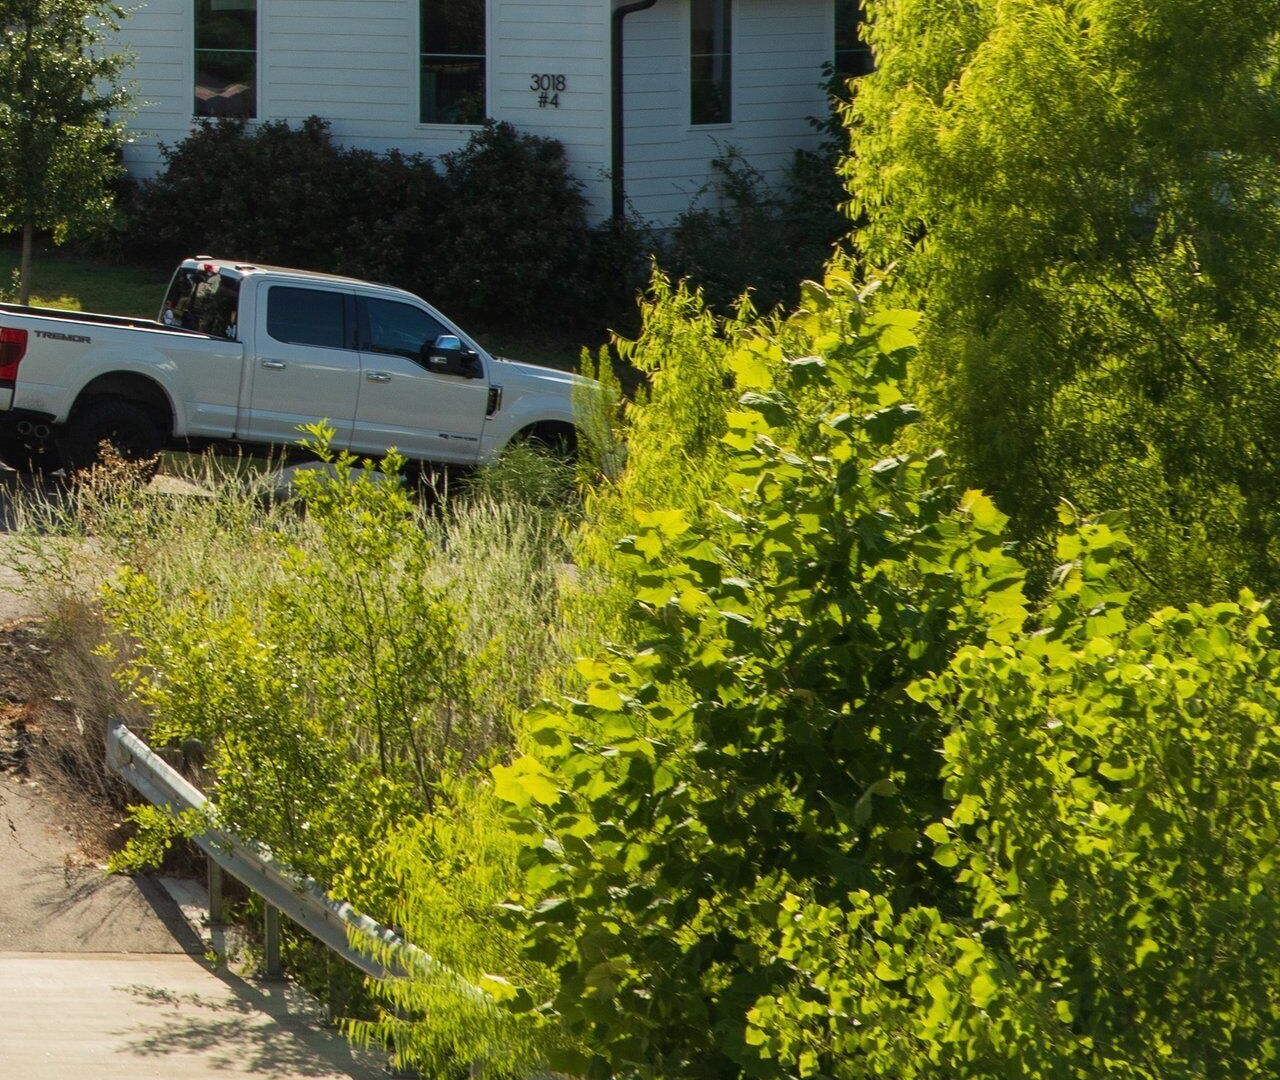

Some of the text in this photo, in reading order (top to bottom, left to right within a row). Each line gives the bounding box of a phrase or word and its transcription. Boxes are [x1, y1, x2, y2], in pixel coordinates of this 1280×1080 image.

[529, 73, 566, 91] 3018
[537, 92, 560, 108] #4
[34, 330, 92, 344] TREMOR
